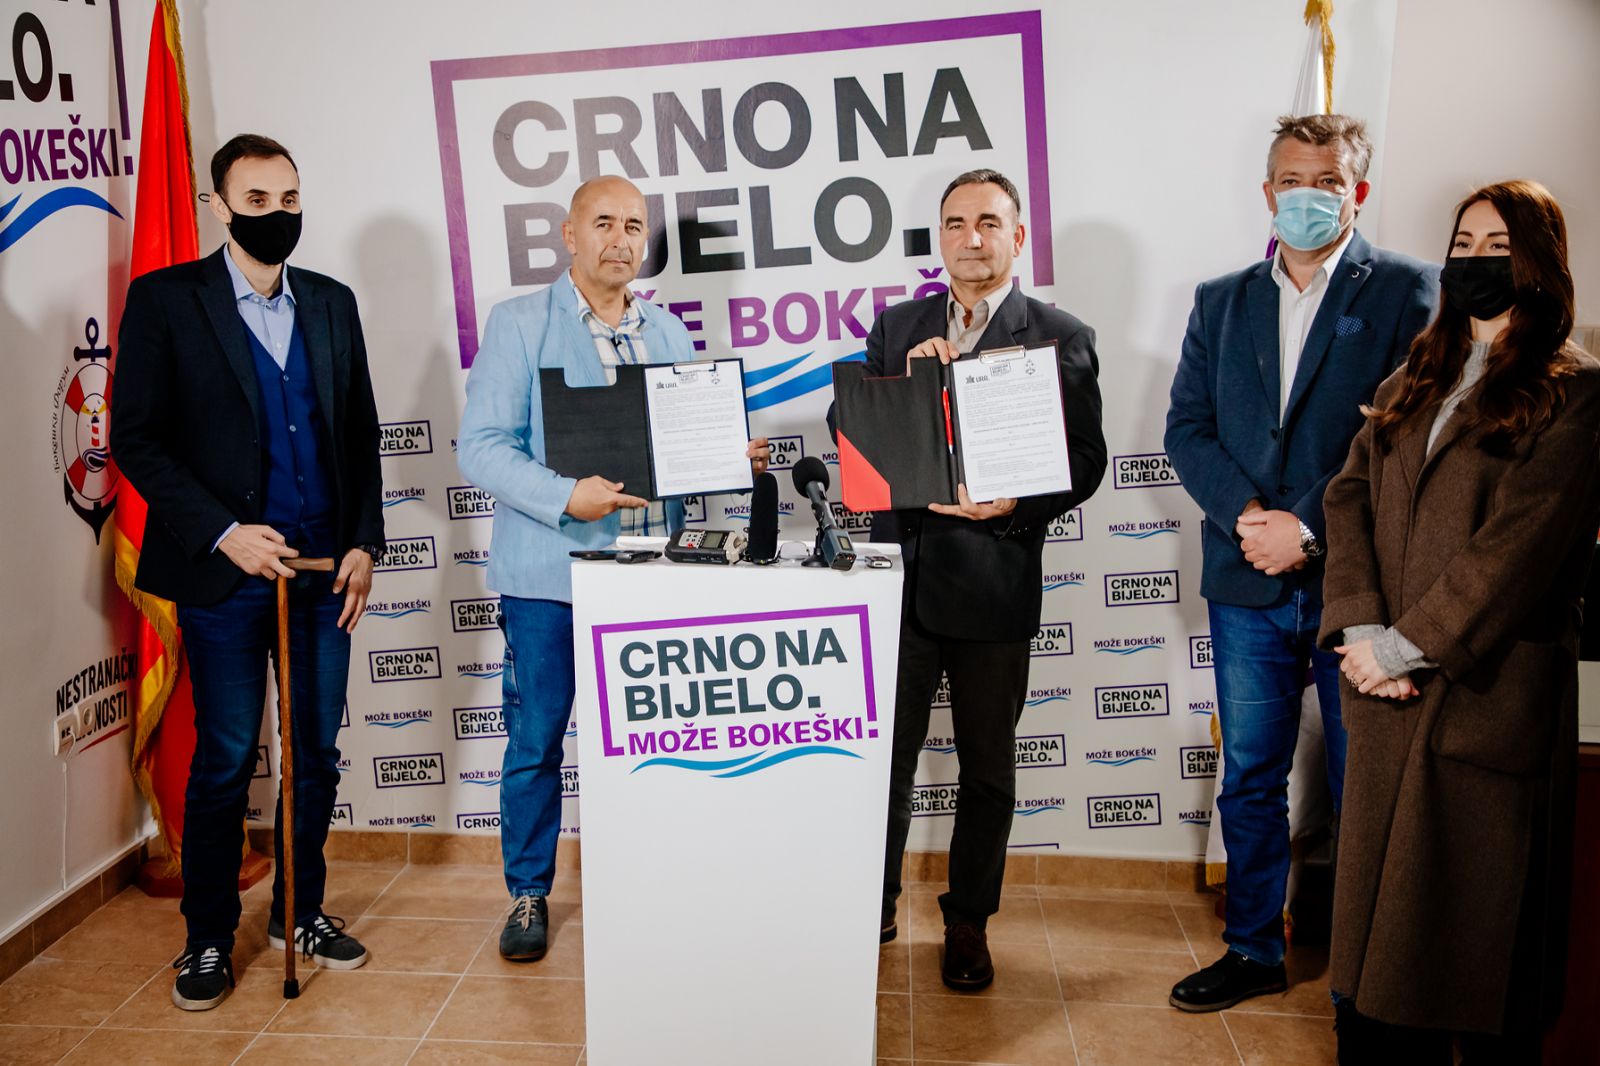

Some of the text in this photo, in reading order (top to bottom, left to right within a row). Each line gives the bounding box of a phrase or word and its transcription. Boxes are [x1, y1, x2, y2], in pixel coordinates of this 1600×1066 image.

[493, 66, 994, 188] CRNO NA
[406, 426, 425, 437] NA
[381, 439, 419, 451] JELO.
[778, 441, 798, 452] NA
[1120, 459, 1160, 471] CRNO
[1121, 470, 1174, 483] BIJELO.
[455, 500, 496, 514] BIJEL
[1109, 519, 1181, 532] MOŽE BOKEŠKI
[411, 542, 429, 552] NA
[454, 550, 480, 560] MOŽE
[1044, 572, 1085, 582] BOKEŠKI
[1111, 576, 1172, 589] CRNO NA
[1112, 588, 1165, 601] BIJELO.
[391, 600, 431, 611] BOKEŠKI
[457, 603, 495, 615] CRNO
[1047, 628, 1066, 639] NA
[1094, 636, 1165, 648] MOŽE BOKEŠKI
[375, 652, 434, 666] CRNO NA
[619, 627, 848, 679] CRNO NA
[377, 664, 428, 677] BIJELO.
[457, 662, 483, 672] MOŽE
[624, 673, 821, 722] BIJELO.
[1031, 687, 1071, 697] BOKEŠKI
[1101, 689, 1162, 702] CRNO NA
[1102, 701, 1155, 713] BIJELO.
[364, 709, 432, 722] MOŽE BOKEŠKI
[459, 711, 497, 723] CRNO
[628, 722, 719, 755] MOŽE
[1040, 740, 1059, 751] NA
[1086, 747, 1156, 759] MOŽE BOKEŠKI
[380, 758, 438, 771] CRNO NA
[381, 770, 431, 783] BIJELO.
[459, 770, 485, 780] MOŽE
[1025, 797, 1065, 807] BOKEŠKI
[1094, 799, 1154, 812] CRNO NA
[369, 816, 395, 826] MOŽE
[1095, 810, 1147, 823] BIJELO.
[463, 817, 500, 829] CRNO
